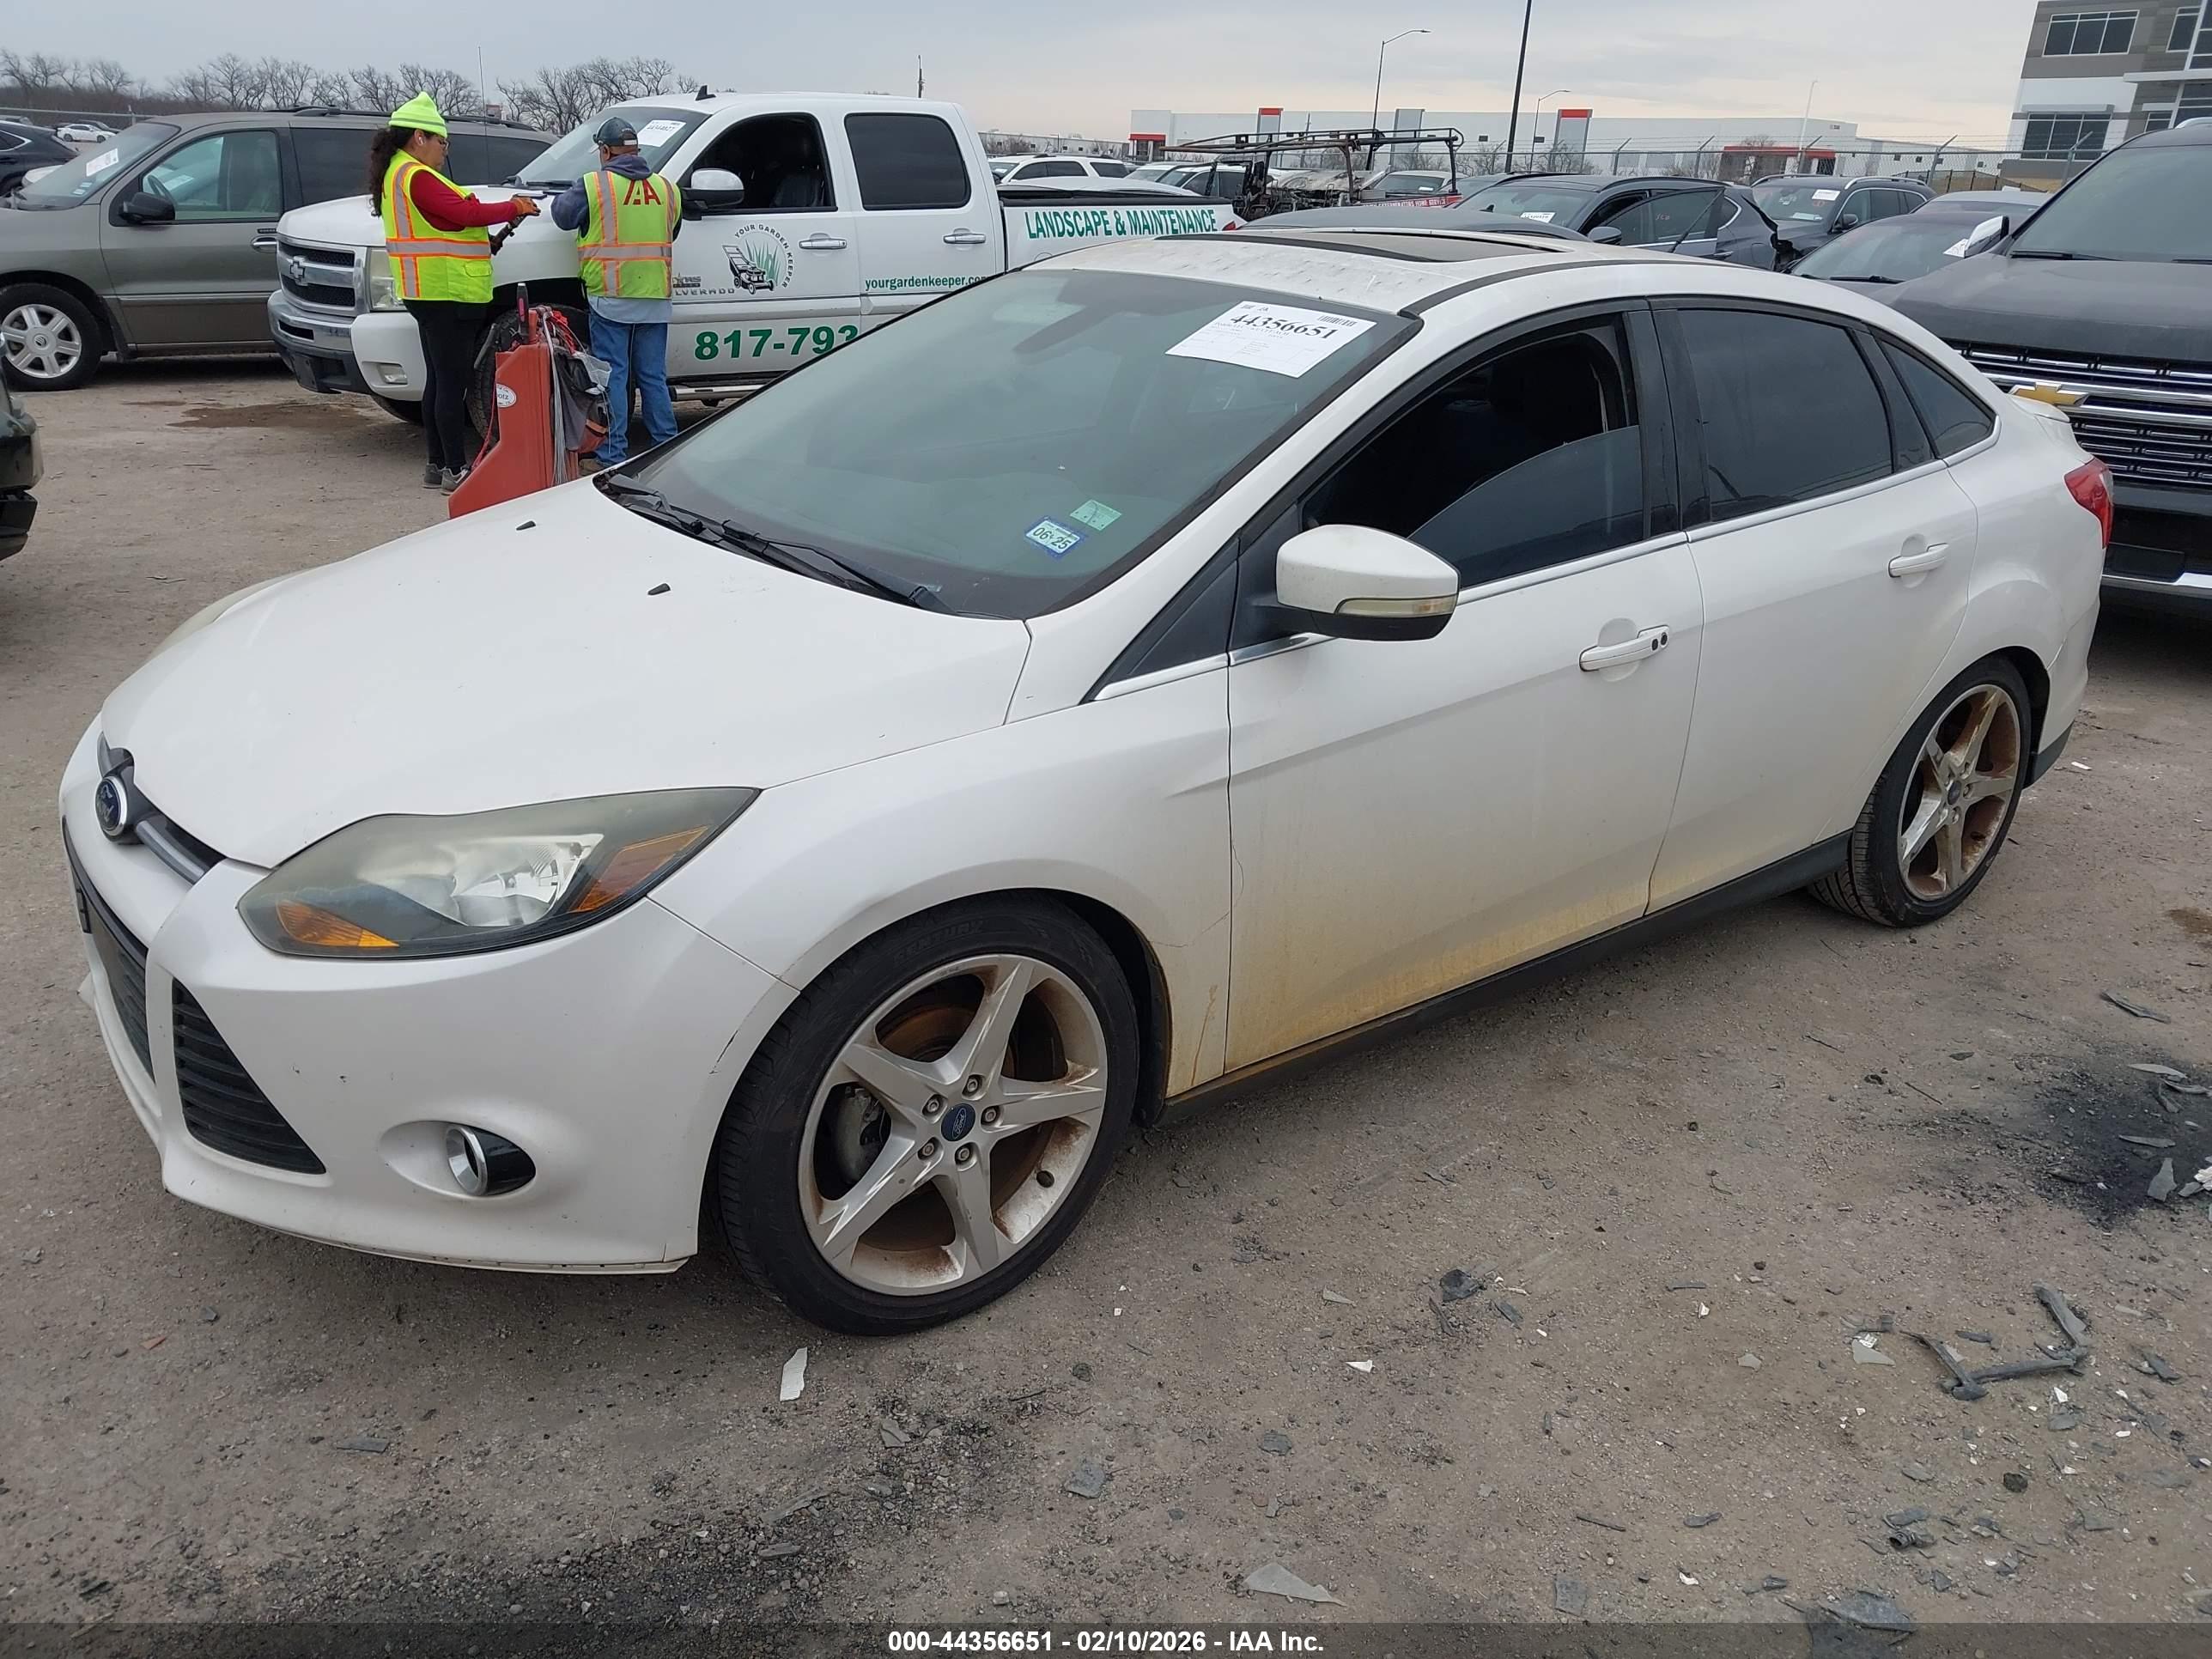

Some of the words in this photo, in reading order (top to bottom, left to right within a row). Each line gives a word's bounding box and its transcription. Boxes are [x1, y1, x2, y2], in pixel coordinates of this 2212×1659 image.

[1024, 210, 1112, 239] LANDSCAPE
[1115, 210, 1127, 235] &
[1127, 209, 1218, 235] MAINTENANCE
[734, 224, 756, 239] YOUR
[758, 224, 789, 249] GARDEN
[781, 252, 793, 289] KEEPER
[1230, 313, 1340, 339] 44356651
[953, 1113, 966, 1135] Ford
